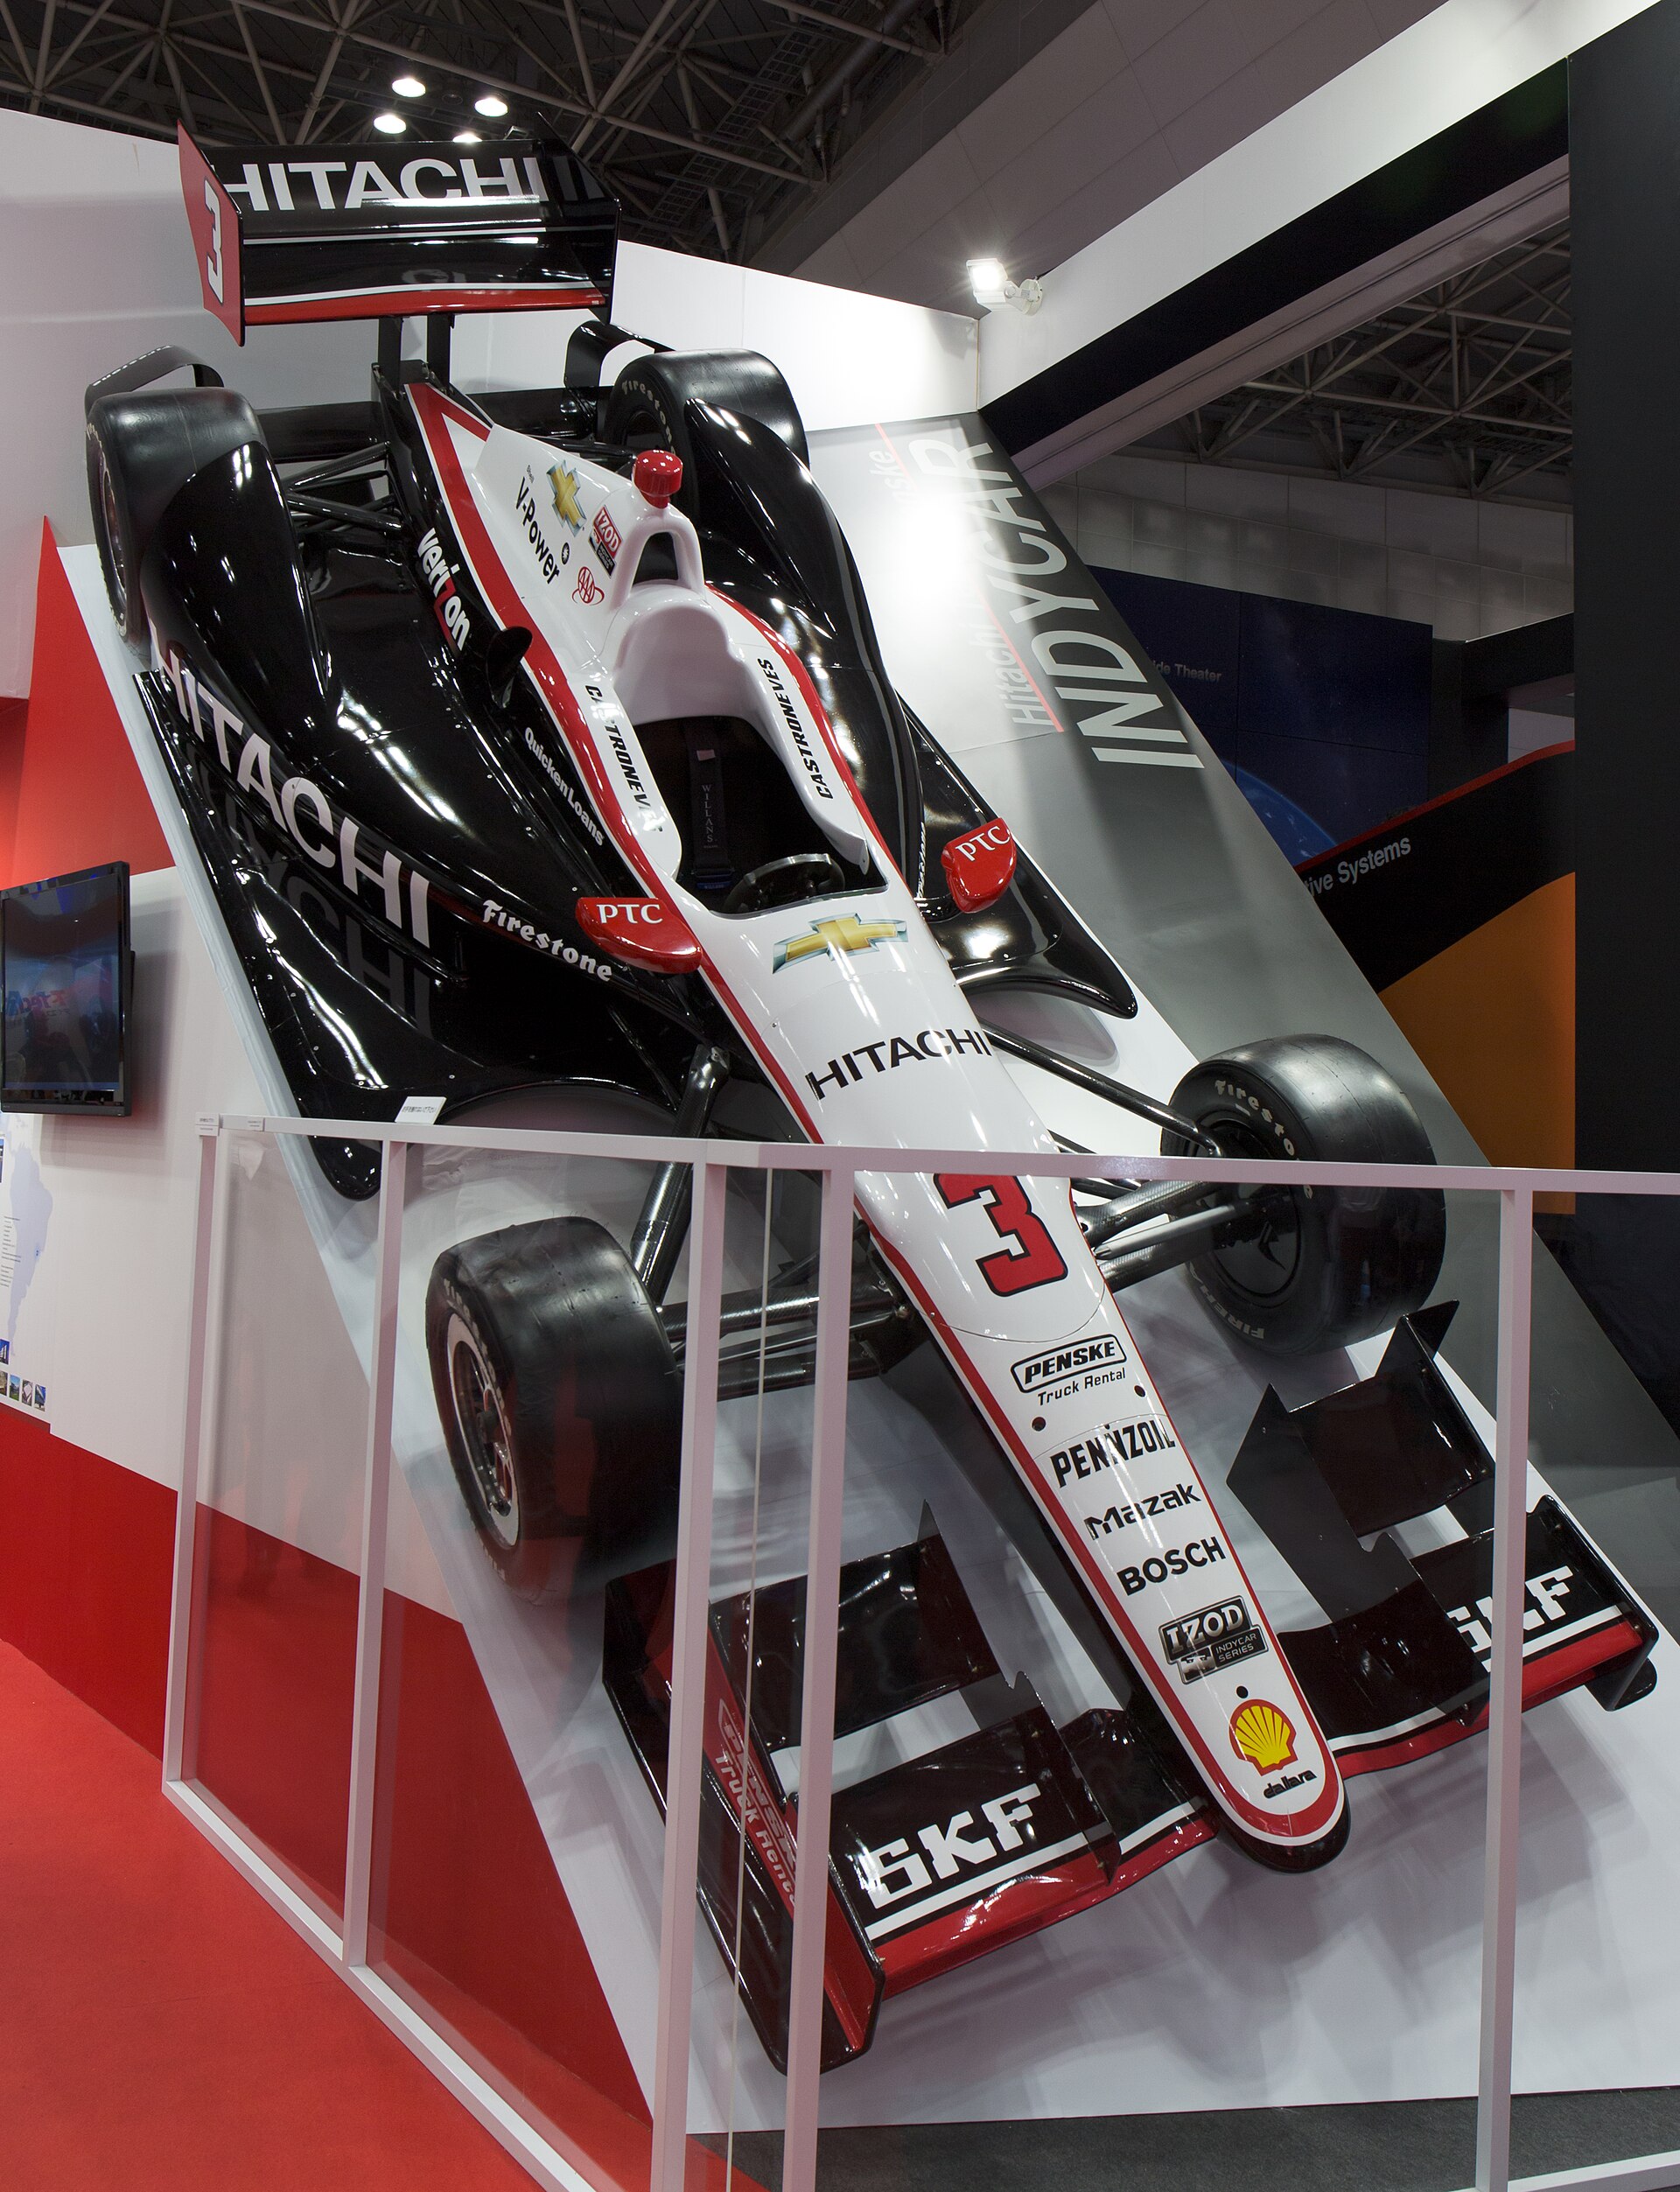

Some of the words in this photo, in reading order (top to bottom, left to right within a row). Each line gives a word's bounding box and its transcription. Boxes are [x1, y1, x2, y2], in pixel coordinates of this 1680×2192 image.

[204, 178, 224, 304] 3
[516, 477, 560, 585] V-Power
[596, 508, 620, 552] IZOD
[417, 528, 470, 654] verizon
[908, 438, 1205, 769] INDYCAR
[1174, 663, 1222, 682] Theater
[758, 658, 833, 799] CASTRONEVES
[150, 618, 430, 949] HITACHI
[955, 825, 1011, 862] PTC
[1338, 837, 1411, 885] Systems
[482, 900, 612, 982] Firestone
[596, 904, 663, 924] PTC
[805, 1029, 992, 1101] HITACHI
[1214, 1080, 1312, 1199] Firestoe
[933, 1173, 1068, 1297] 3
[1025, 1341, 1116, 1385] PENSKE
[1038, 1381, 1079, 1406] Truck
[1084, 1367, 1126, 1390] Rental
[1050, 1418, 1176, 1488] PENNZOIL
[1083, 1483, 1201, 1540] Mazak
[1116, 1536, 1226, 1597] BOSCH
[1166, 1604, 1243, 1654] IZOD
[1215, 1632, 1257, 1654] INDYCAR
[1218, 1642, 1255, 1663] SERIES
[864, 1782, 1041, 1909] SKF
